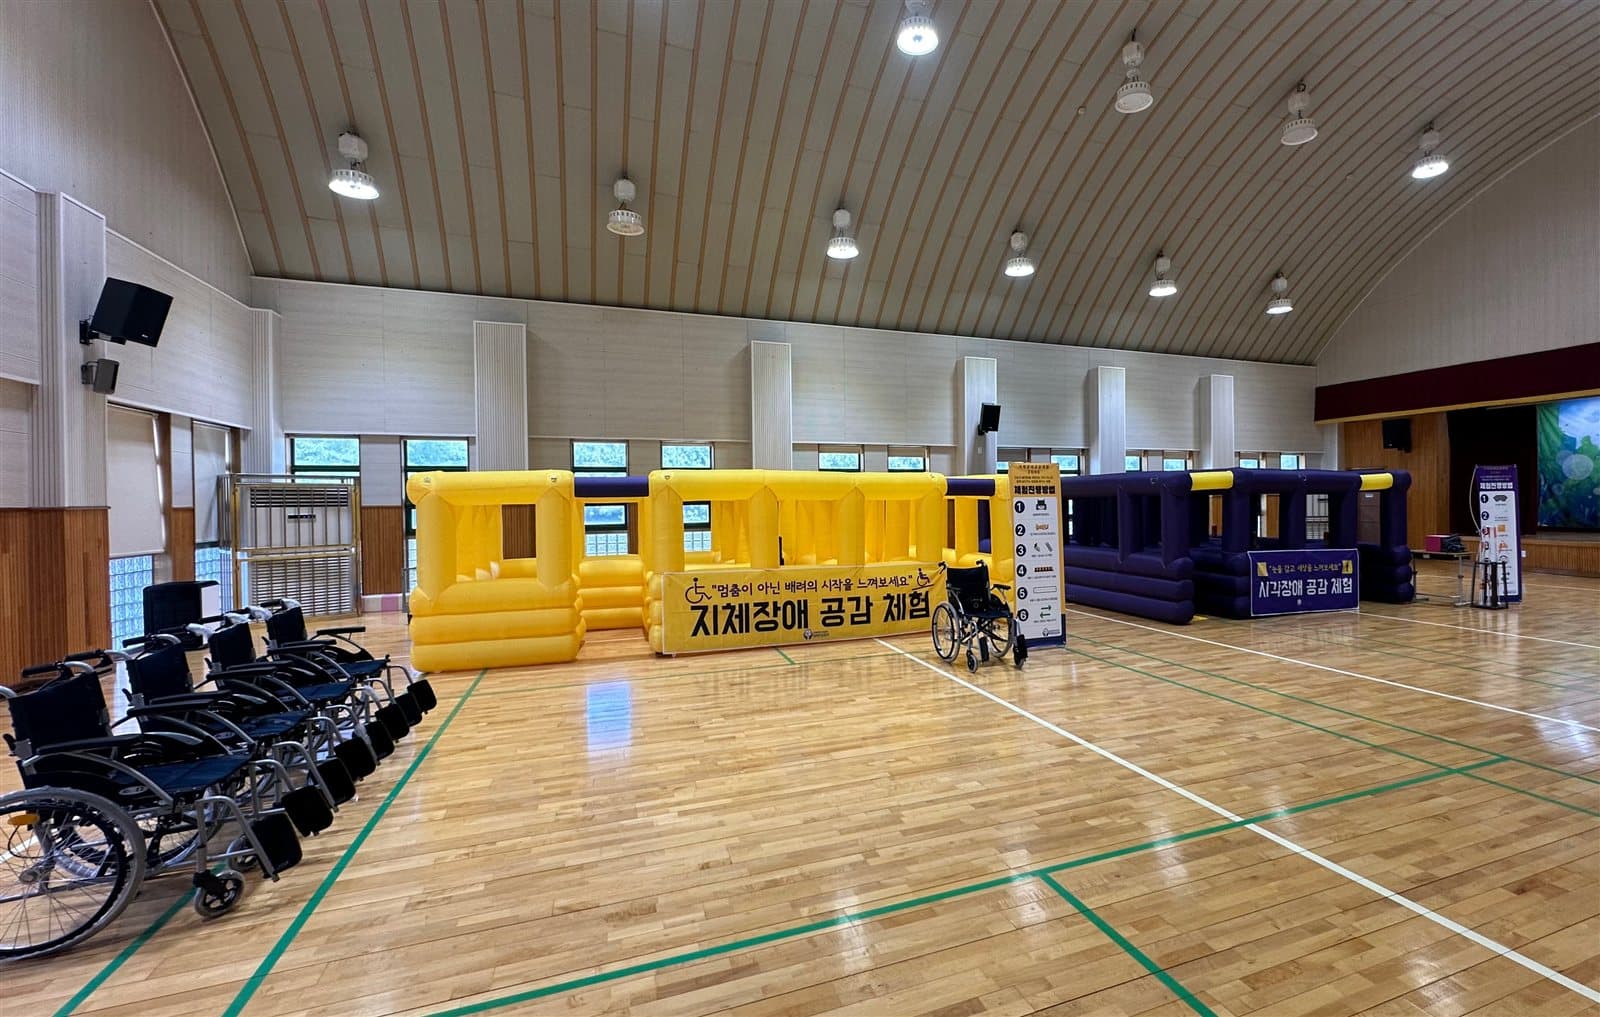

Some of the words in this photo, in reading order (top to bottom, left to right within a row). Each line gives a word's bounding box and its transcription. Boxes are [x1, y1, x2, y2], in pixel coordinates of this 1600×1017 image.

[1016, 501, 1024, 512] 1
[1016, 525, 1025, 536] 2
[1017, 545, 1025, 556] 3
[1018, 565, 1026, 576] 4
[711, 581, 753, 598] "멈춤이
[757, 581, 780, 595] 아닌
[785, 579, 818, 593] 배려의
[822, 578, 854, 592] 시작을
[857, 574, 913, 590] 느껴보세요"
[1259, 579, 1303, 598] 시각장애
[1306, 578, 1328, 596] 공감
[1331, 577, 1353, 595] 체험
[1018, 588, 1027, 599] 5
[690, 599, 809, 638] 지체장애
[820, 595, 874, 628] 공감
[882, 590, 931, 623] 체험
[1019, 609, 1028, 621] 6
